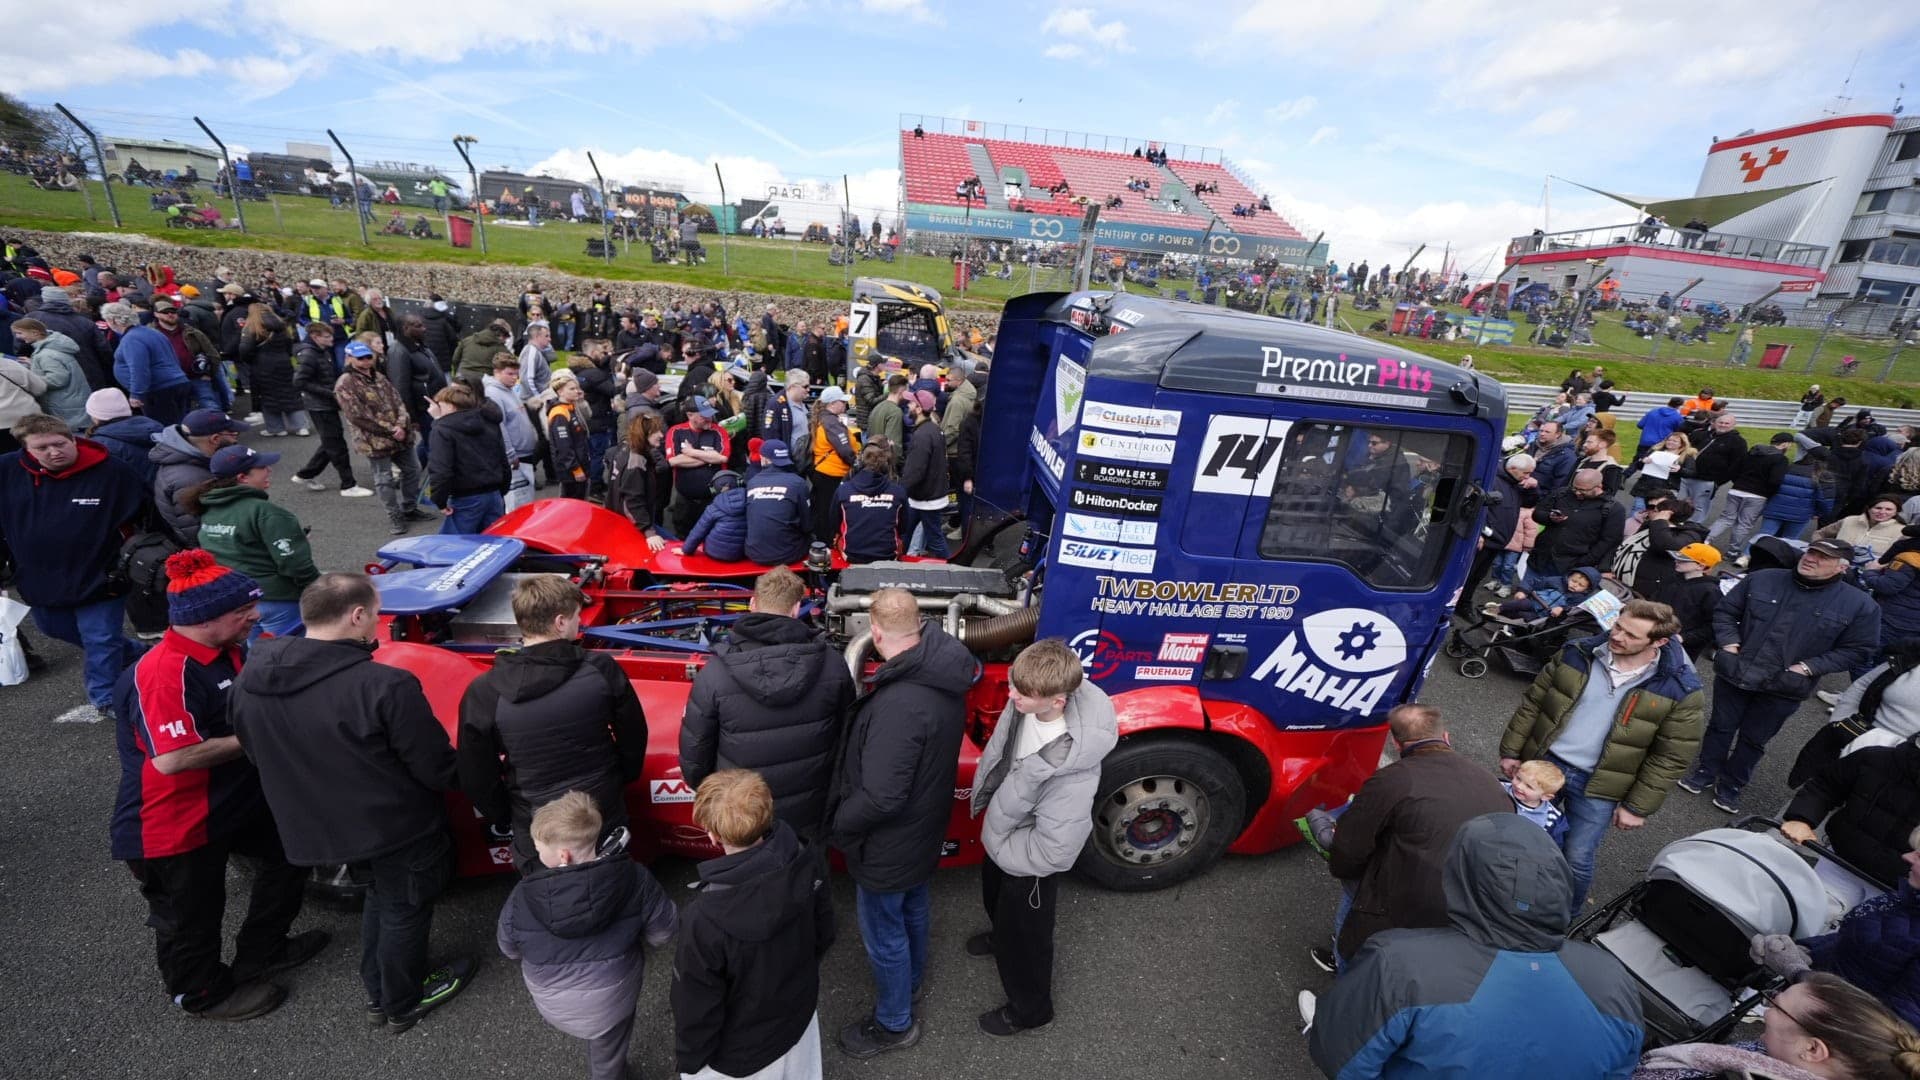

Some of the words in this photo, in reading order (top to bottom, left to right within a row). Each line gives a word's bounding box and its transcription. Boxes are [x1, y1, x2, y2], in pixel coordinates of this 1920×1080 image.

[625, 193, 646, 204] HOT
[649, 196, 677, 208] DOGS
[928, 215, 973, 227] BRANDS
[977, 218, 1013, 230] HATCH
[1030, 218, 1063, 238] 100
[1092, 227, 1137, 241] CENTURY
[1141, 233, 1155, 243] OF
[1158, 234, 1194, 246] POWER
[1209, 235, 1240, 256] 100
[854, 310, 870, 333] 7
[1102, 411, 1162, 426] Clutchfix
[1100, 436, 1173, 453] CENTURION
[1202, 433, 1283, 480] 14
[1094, 474, 1130, 485] BOARDING
[1131, 478, 1162, 487] CATTERY
[1100, 466, 1157, 480] BOWLER'S
[1086, 494, 1158, 512] HiltonDocker
[1121, 550, 1153, 565] fleet
[1091, 597, 1148, 615] HEAVY
[1148, 602, 1223, 618] HAULAGE
[1225, 605, 1258, 619] EST
[1104, 650, 1153, 662] PARTS
[1158, 642, 1205, 661] Motor
[1137, 667, 1192, 677] FRUEHAUF
[1251, 630, 1399, 717] MAHA
